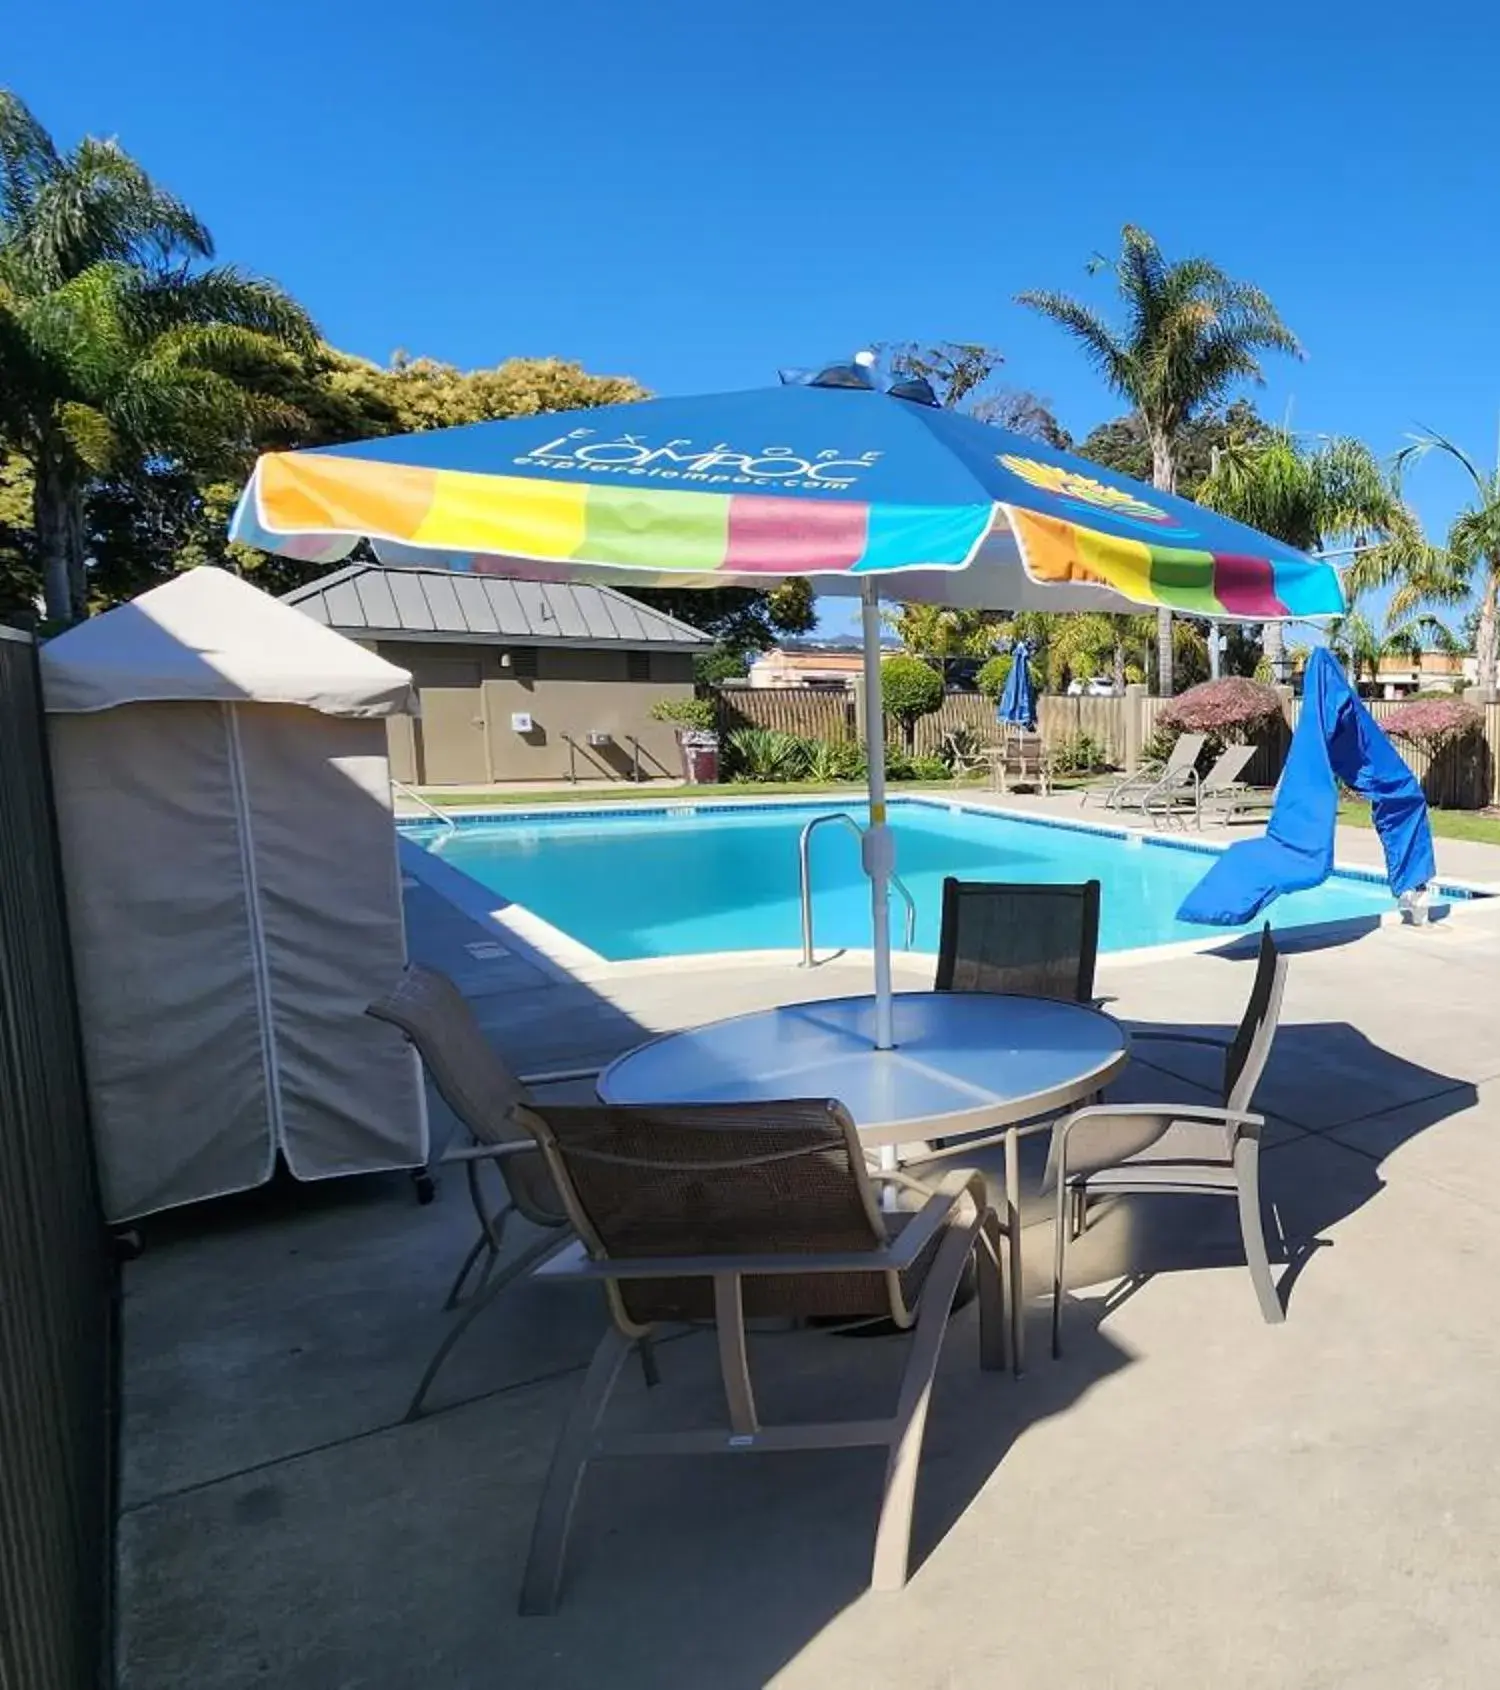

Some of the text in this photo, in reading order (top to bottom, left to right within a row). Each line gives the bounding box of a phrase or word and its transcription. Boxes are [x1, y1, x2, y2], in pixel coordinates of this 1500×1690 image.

[528, 437, 874, 482] LOMPOC
[568, 428, 886, 462] EXPLORE
[513, 457, 849, 490] explorelompoc.com
